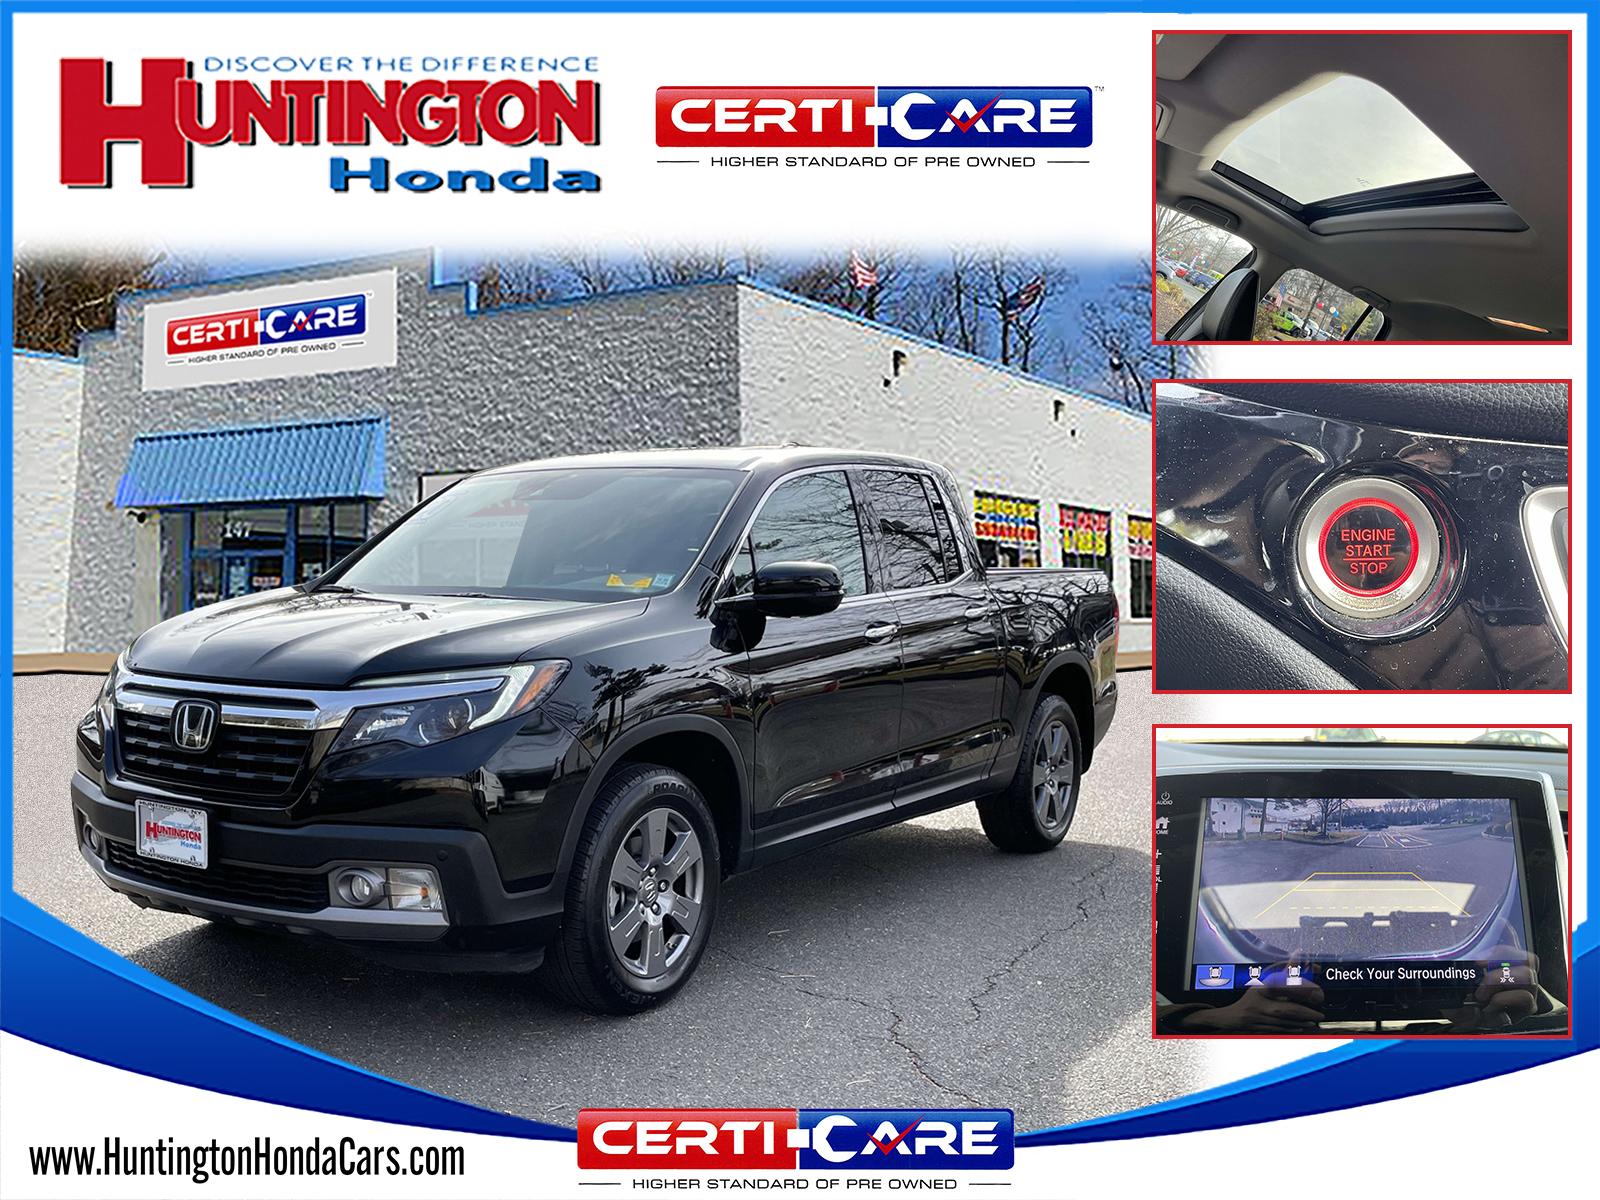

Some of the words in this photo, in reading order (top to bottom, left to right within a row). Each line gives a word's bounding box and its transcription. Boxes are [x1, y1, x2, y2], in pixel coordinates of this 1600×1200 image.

[188, 353, 218, 364] HIGHER
[219, 349, 265, 361] STANDARD
[266, 347, 279, 357] OF
[280, 344, 299, 355] PRE
[300, 341, 337, 354] OWNED
[223, 521, 252, 539] 147
[1341, 528, 1396, 542] ENGINE
[1345, 544, 1392, 557] START
[1349, 561, 1388, 575] STOP
[146, 821, 202, 842] HUNTINGTON
[180, 841, 202, 850] Honda
[140, 851, 179, 862] HUNTINGTON
[1326, 966, 1364, 981] Check
[1366, 967, 1395, 981] Your
[1397, 966, 1477, 982] Surroundings
